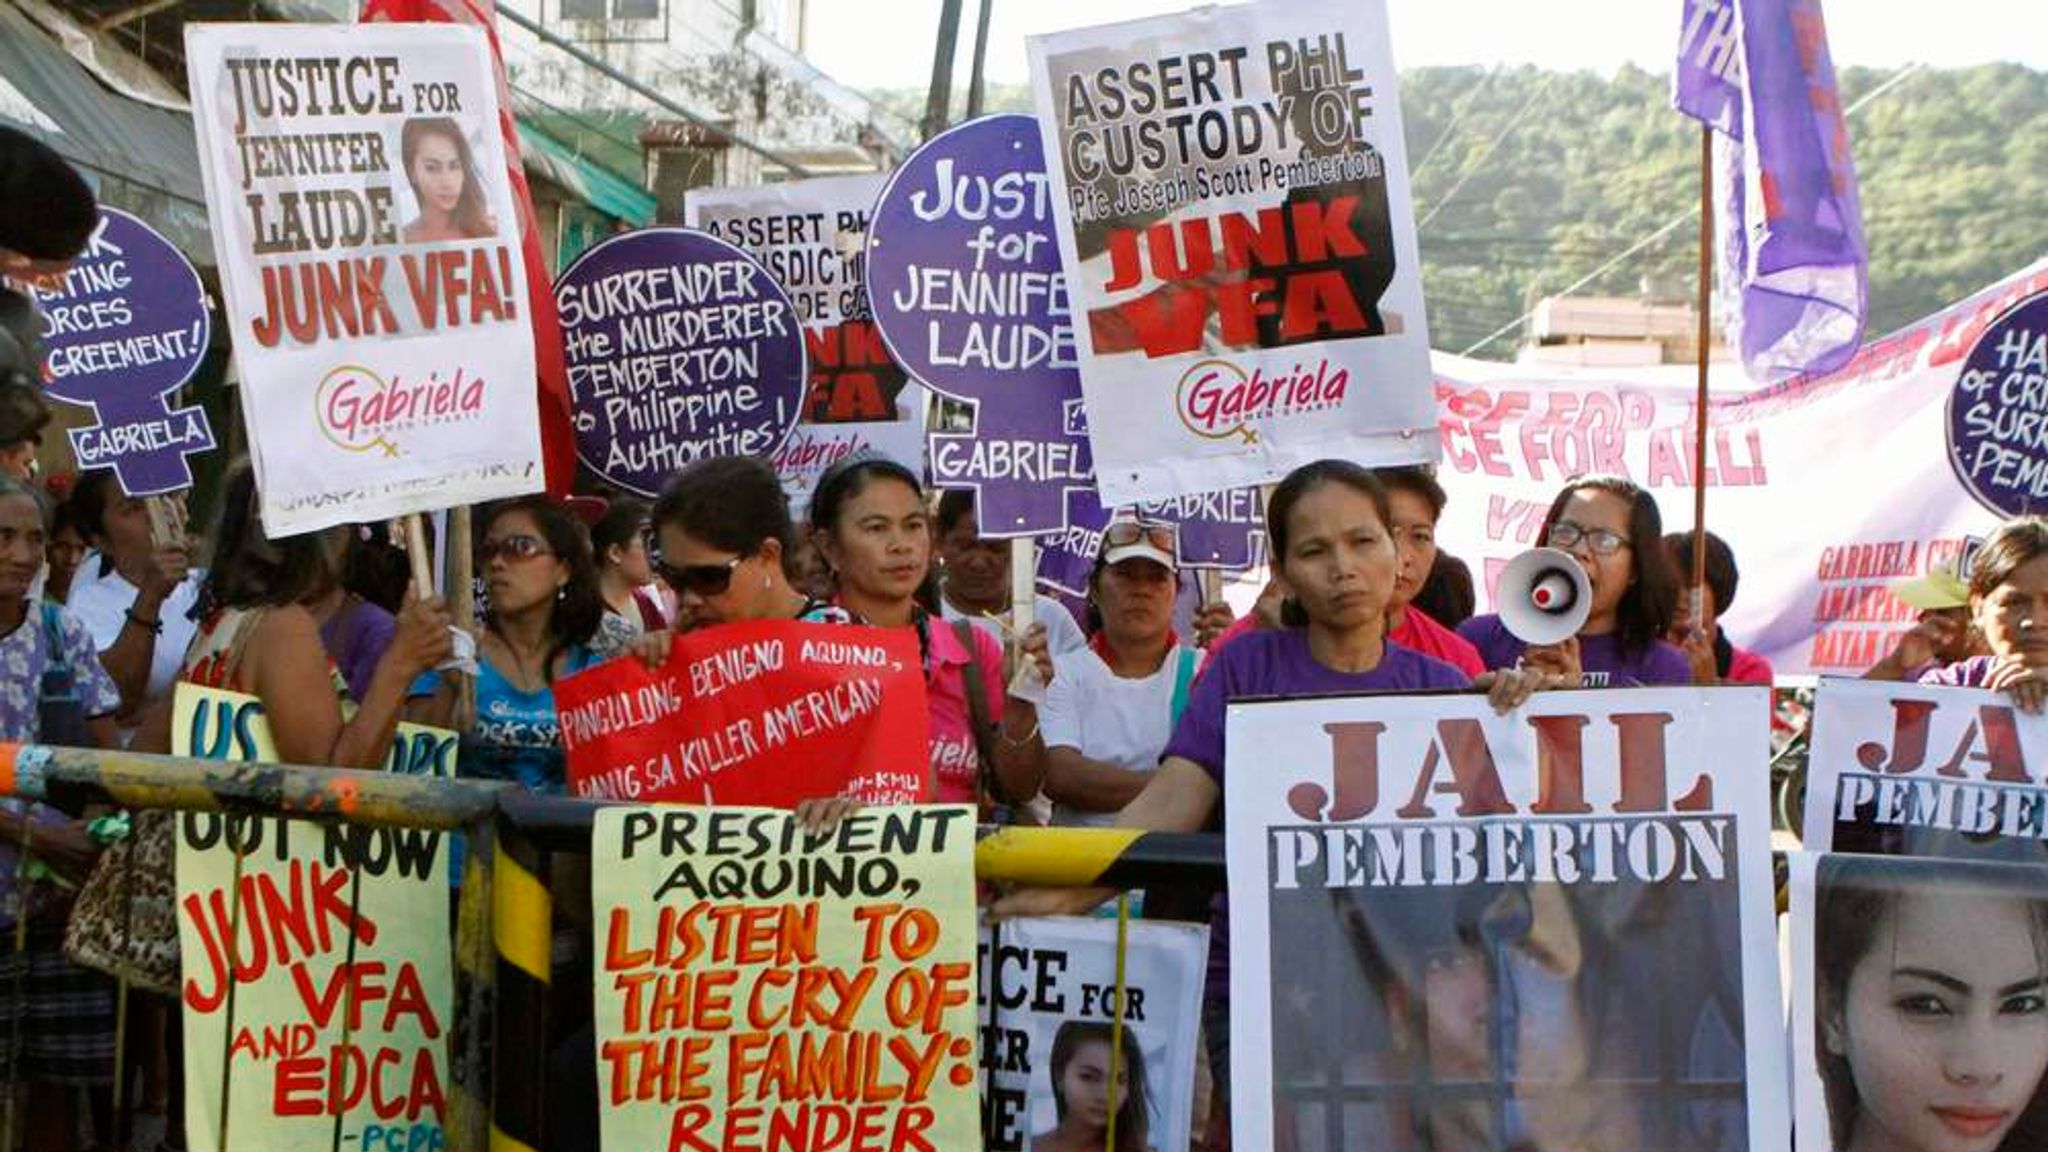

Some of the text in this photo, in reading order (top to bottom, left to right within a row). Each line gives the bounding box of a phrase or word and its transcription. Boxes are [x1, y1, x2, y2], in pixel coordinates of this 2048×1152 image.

[226, 55, 462, 134] JUSTICE FOR
[1066, 33, 1365, 128] ASSERT PHL
[236, 131, 390, 190] JENNIFER
[1069, 86, 1374, 181] CUSTODY OF
[1115, 170, 1188, 215] Joseph
[1195, 163, 1254, 200] Scott
[1258, 147, 1382, 192] Pemberton
[246, 186, 397, 255] LAUDE
[966, 226, 1049, 270] for
[1104, 195, 1369, 293] JUNK
[252, 246, 517, 348] JUNK VFA!
[557, 260, 759, 329] SURRENDER
[47, 319, 201, 383] GREEMENT!
[565, 300, 788, 363] the MURDERER
[328, 367, 484, 440] Gabriela
[566, 339, 760, 403] PEMBERTON
[1188, 359, 1348, 429] Gabriela
[1960, 368, 1998, 401] OF
[78, 414, 206, 460] GABRIELA
[604, 383, 763, 435] Philippine
[1818, 541, 1918, 581] GABRIELA
[689, 639, 784, 698] BENIGNO
[800, 640, 902, 671] AQUINO,
[645, 753, 676, 791] SA
[680, 721, 759, 778] KILLER
[763, 677, 883, 750] AMERICAN
[1287, 713, 1714, 822] JAIL
[1838, 776, 2048, 840] PEMBE
[653, 857, 922, 901] AQUINO,
[1273, 819, 1727, 889] PEMBERTON
[184, 859, 378, 1013] JUNK
[605, 901, 940, 971] LISTEN TO
[291, 961, 440, 1039] VFA
[614, 962, 971, 1034] THE CRY OF
[1080, 983, 1146, 1021] FOR
[228, 1023, 316, 1060] AND
[602, 1031, 974, 1106] THE FAMILY:
[273, 1044, 446, 1123] EDCA
[668, 1103, 938, 1152] RENDER
